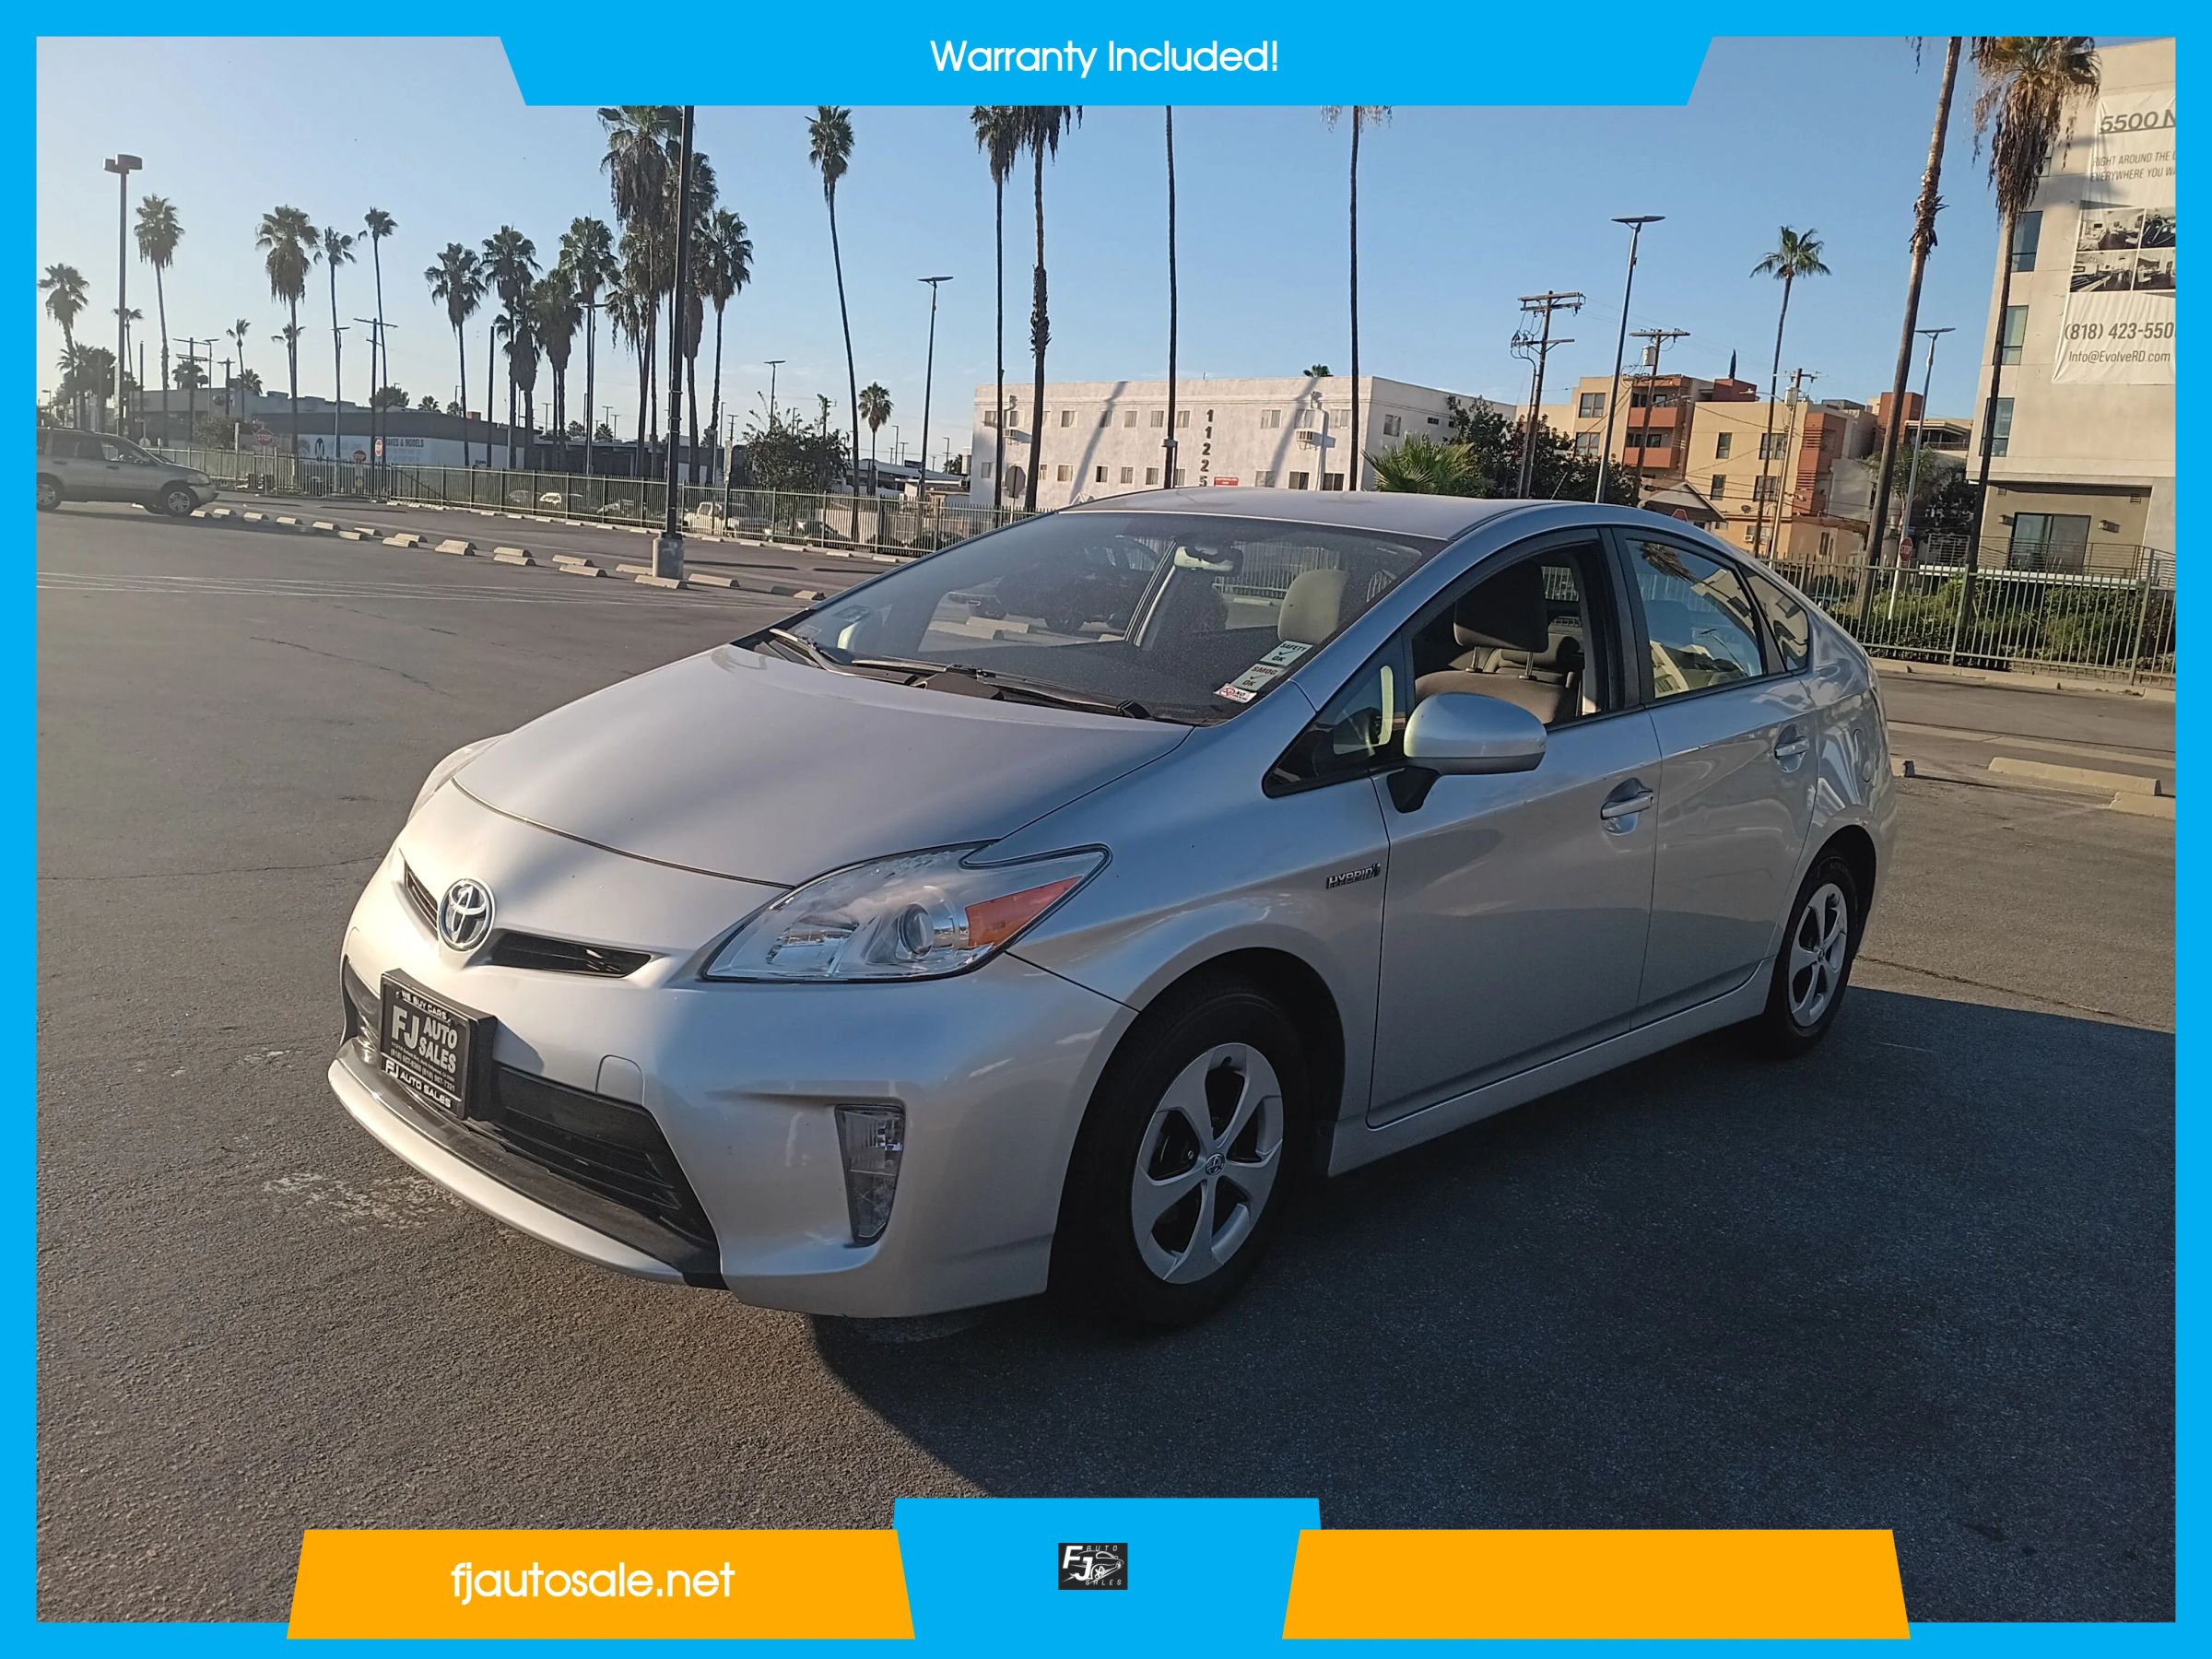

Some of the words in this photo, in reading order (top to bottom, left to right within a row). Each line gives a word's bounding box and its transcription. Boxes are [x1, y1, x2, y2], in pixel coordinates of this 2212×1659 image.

[2100, 111, 2159, 134] 5500
[2094, 155, 2116, 167] RIGHT
[2118, 152, 2153, 165] AROUND
[2155, 151, 2171, 161] THE
[2090, 168, 2145, 182] EVERYWHERE
[2147, 167, 2163, 178] YOU
[2065, 323, 2103, 340] (818)
[2108, 322, 2175, 339] 423-550
[2068, 349, 2171, 364] Info@EvolveRD.com
[1900, 545, 1912, 555] STOP
[1280, 642, 1306, 652] SAFETY
[1252, 665, 1278, 676] SMOG
[1326, 866, 1374, 889] HYBRID
[401, 989, 412, 1003] WE
[412, 995, 427, 1010] BUY
[427, 1004, 448, 1020] CARS
[392, 1005, 419, 1050] FJ
[423, 1017, 458, 1050] AUTO
[418, 1036, 457, 1074] SALES
[385, 1059, 399, 1078] FJ
[400, 1071, 423, 1091] AUTO
[423, 1084, 452, 1108] SALES
